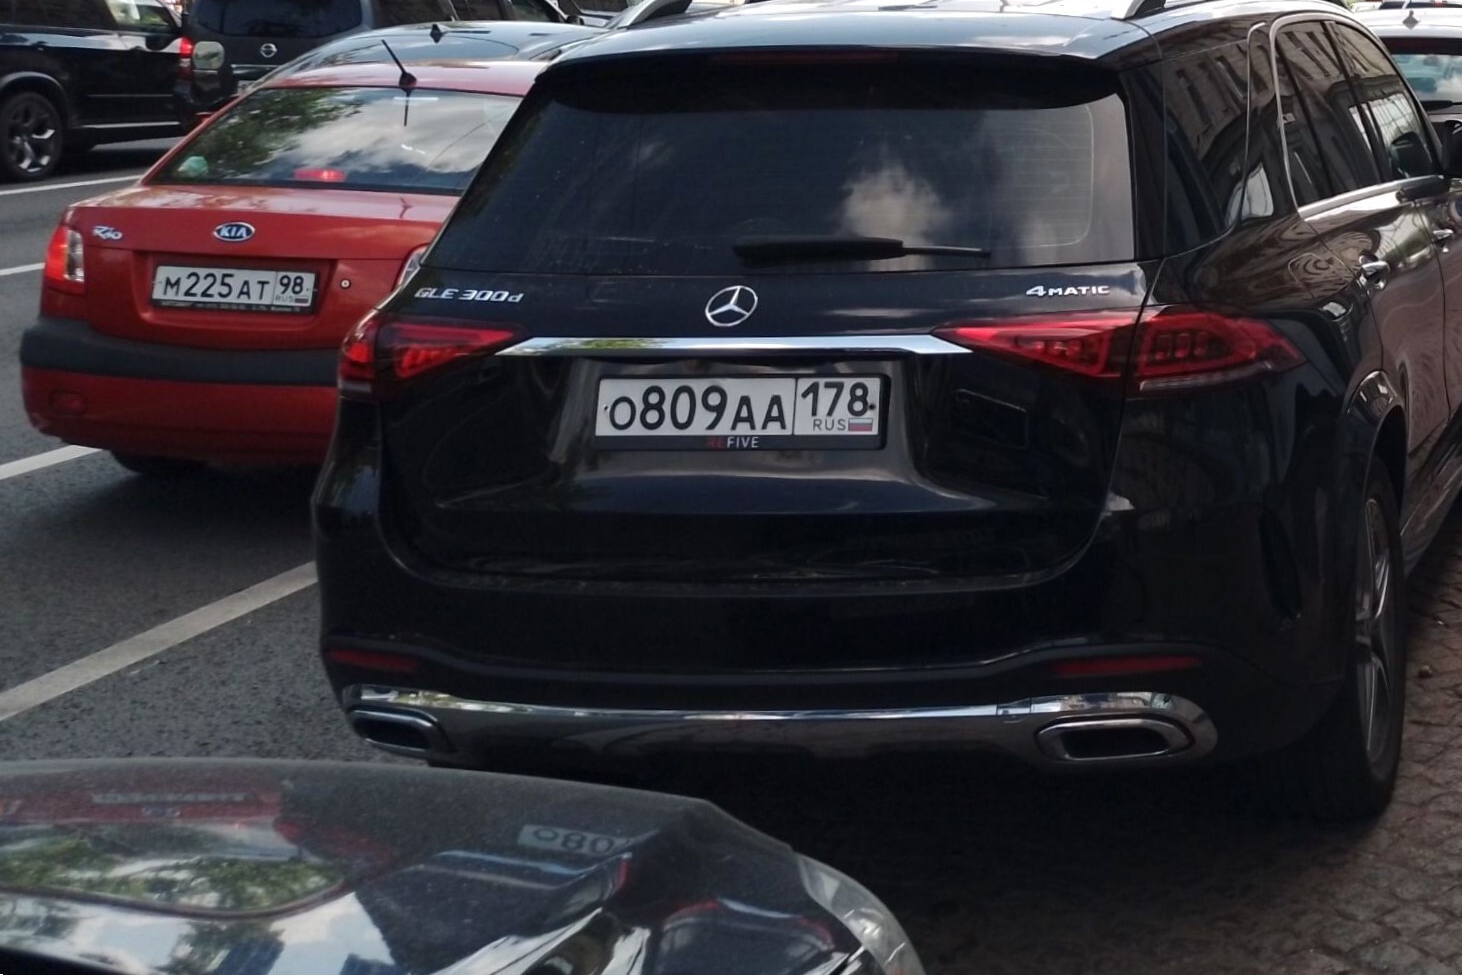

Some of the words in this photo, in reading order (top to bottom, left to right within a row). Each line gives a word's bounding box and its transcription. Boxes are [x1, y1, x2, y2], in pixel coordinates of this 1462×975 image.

[279, 275, 304, 296] 98
[1026, 285, 1111, 297] 4MATIC
[414, 287, 459, 300] GLE
[458, 289, 524, 303] 300d
[801, 381, 869, 417] 178
[812, 418, 846, 432] RUS
